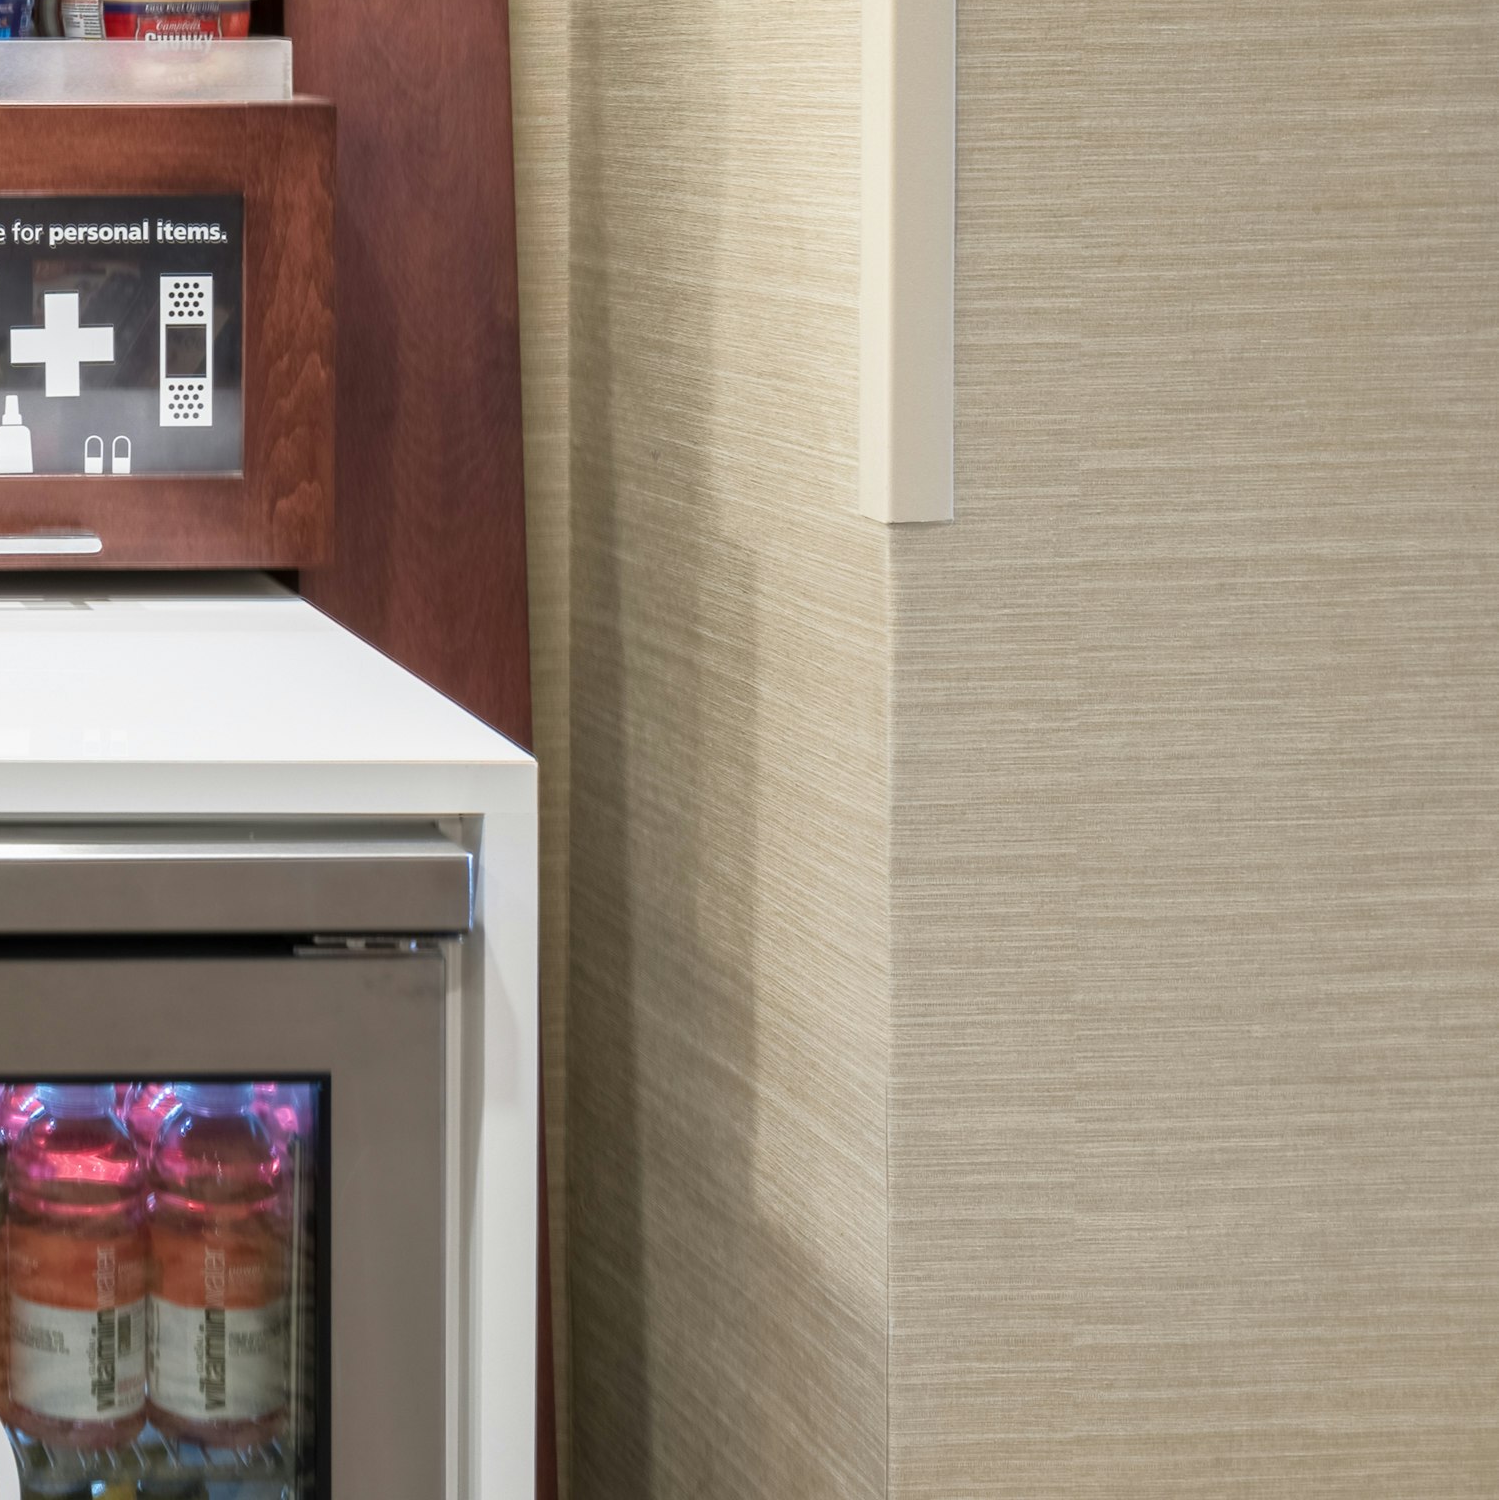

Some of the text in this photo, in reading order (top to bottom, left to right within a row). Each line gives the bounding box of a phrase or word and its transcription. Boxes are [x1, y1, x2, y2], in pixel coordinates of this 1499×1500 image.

[11, 221, 44, 243] for
[48, 221, 150, 248] personal
[156, 221, 228, 243] items.
